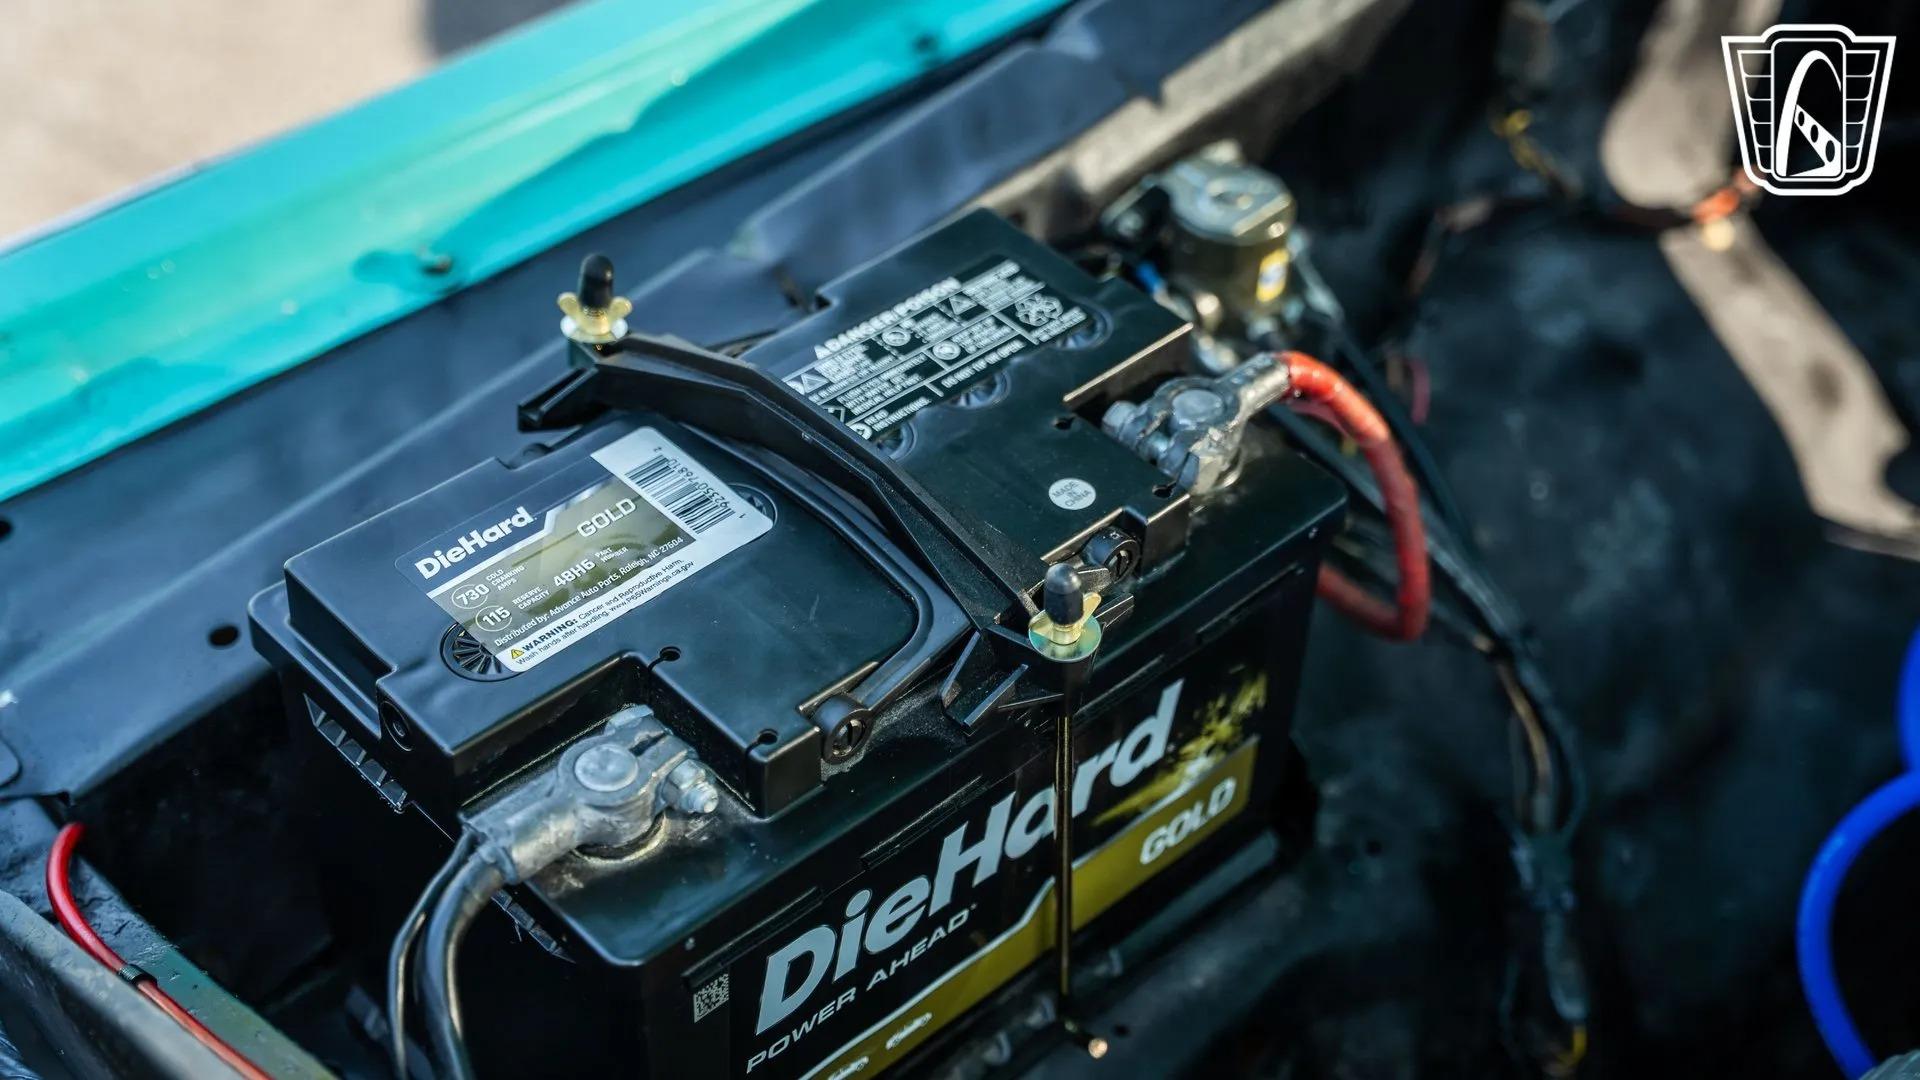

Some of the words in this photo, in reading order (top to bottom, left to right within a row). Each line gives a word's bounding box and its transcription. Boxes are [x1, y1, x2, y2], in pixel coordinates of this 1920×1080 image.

[576, 498, 636, 538] GOLD
[415, 506, 535, 580] DieHard
[594, 547, 613, 559] PART
[600, 547, 629, 563] NUMBER
[486, 569, 504, 581] COLD
[497, 578, 518, 591] AMPS
[553, 559, 596, 587] 48H6
[456, 583, 490, 605] 730
[494, 618, 537, 646] Distributed
[535, 613, 550, 623] by:
[548, 595, 581, 616] Advance
[579, 585, 599, 598] Auto
[597, 571, 621, 588] Parts,
[619, 555, 649, 575] Raleigh,
[647, 548, 660, 559] NC
[658, 535, 684, 553] 27604
[512, 586, 543, 605] RESERVE
[519, 589, 550, 610] CAPACITY
[522, 617, 578, 652] WARNING:
[578, 603, 604, 620] Cancer
[604, 595, 618, 606] and
[617, 570, 663, 599] Reproductive
[661, 557, 684, 572] Harm.
[482, 606, 511, 626] 115
[516, 649, 538, 665] Wash
[537, 636, 561, 652] hands
[560, 626, 577, 639] after
[1139, 776, 1237, 866] GOLD
[756, 678, 1185, 1036] DieHard
[746, 986, 857, 1074] POWER
[866, 908, 972, 992] AHEAD
